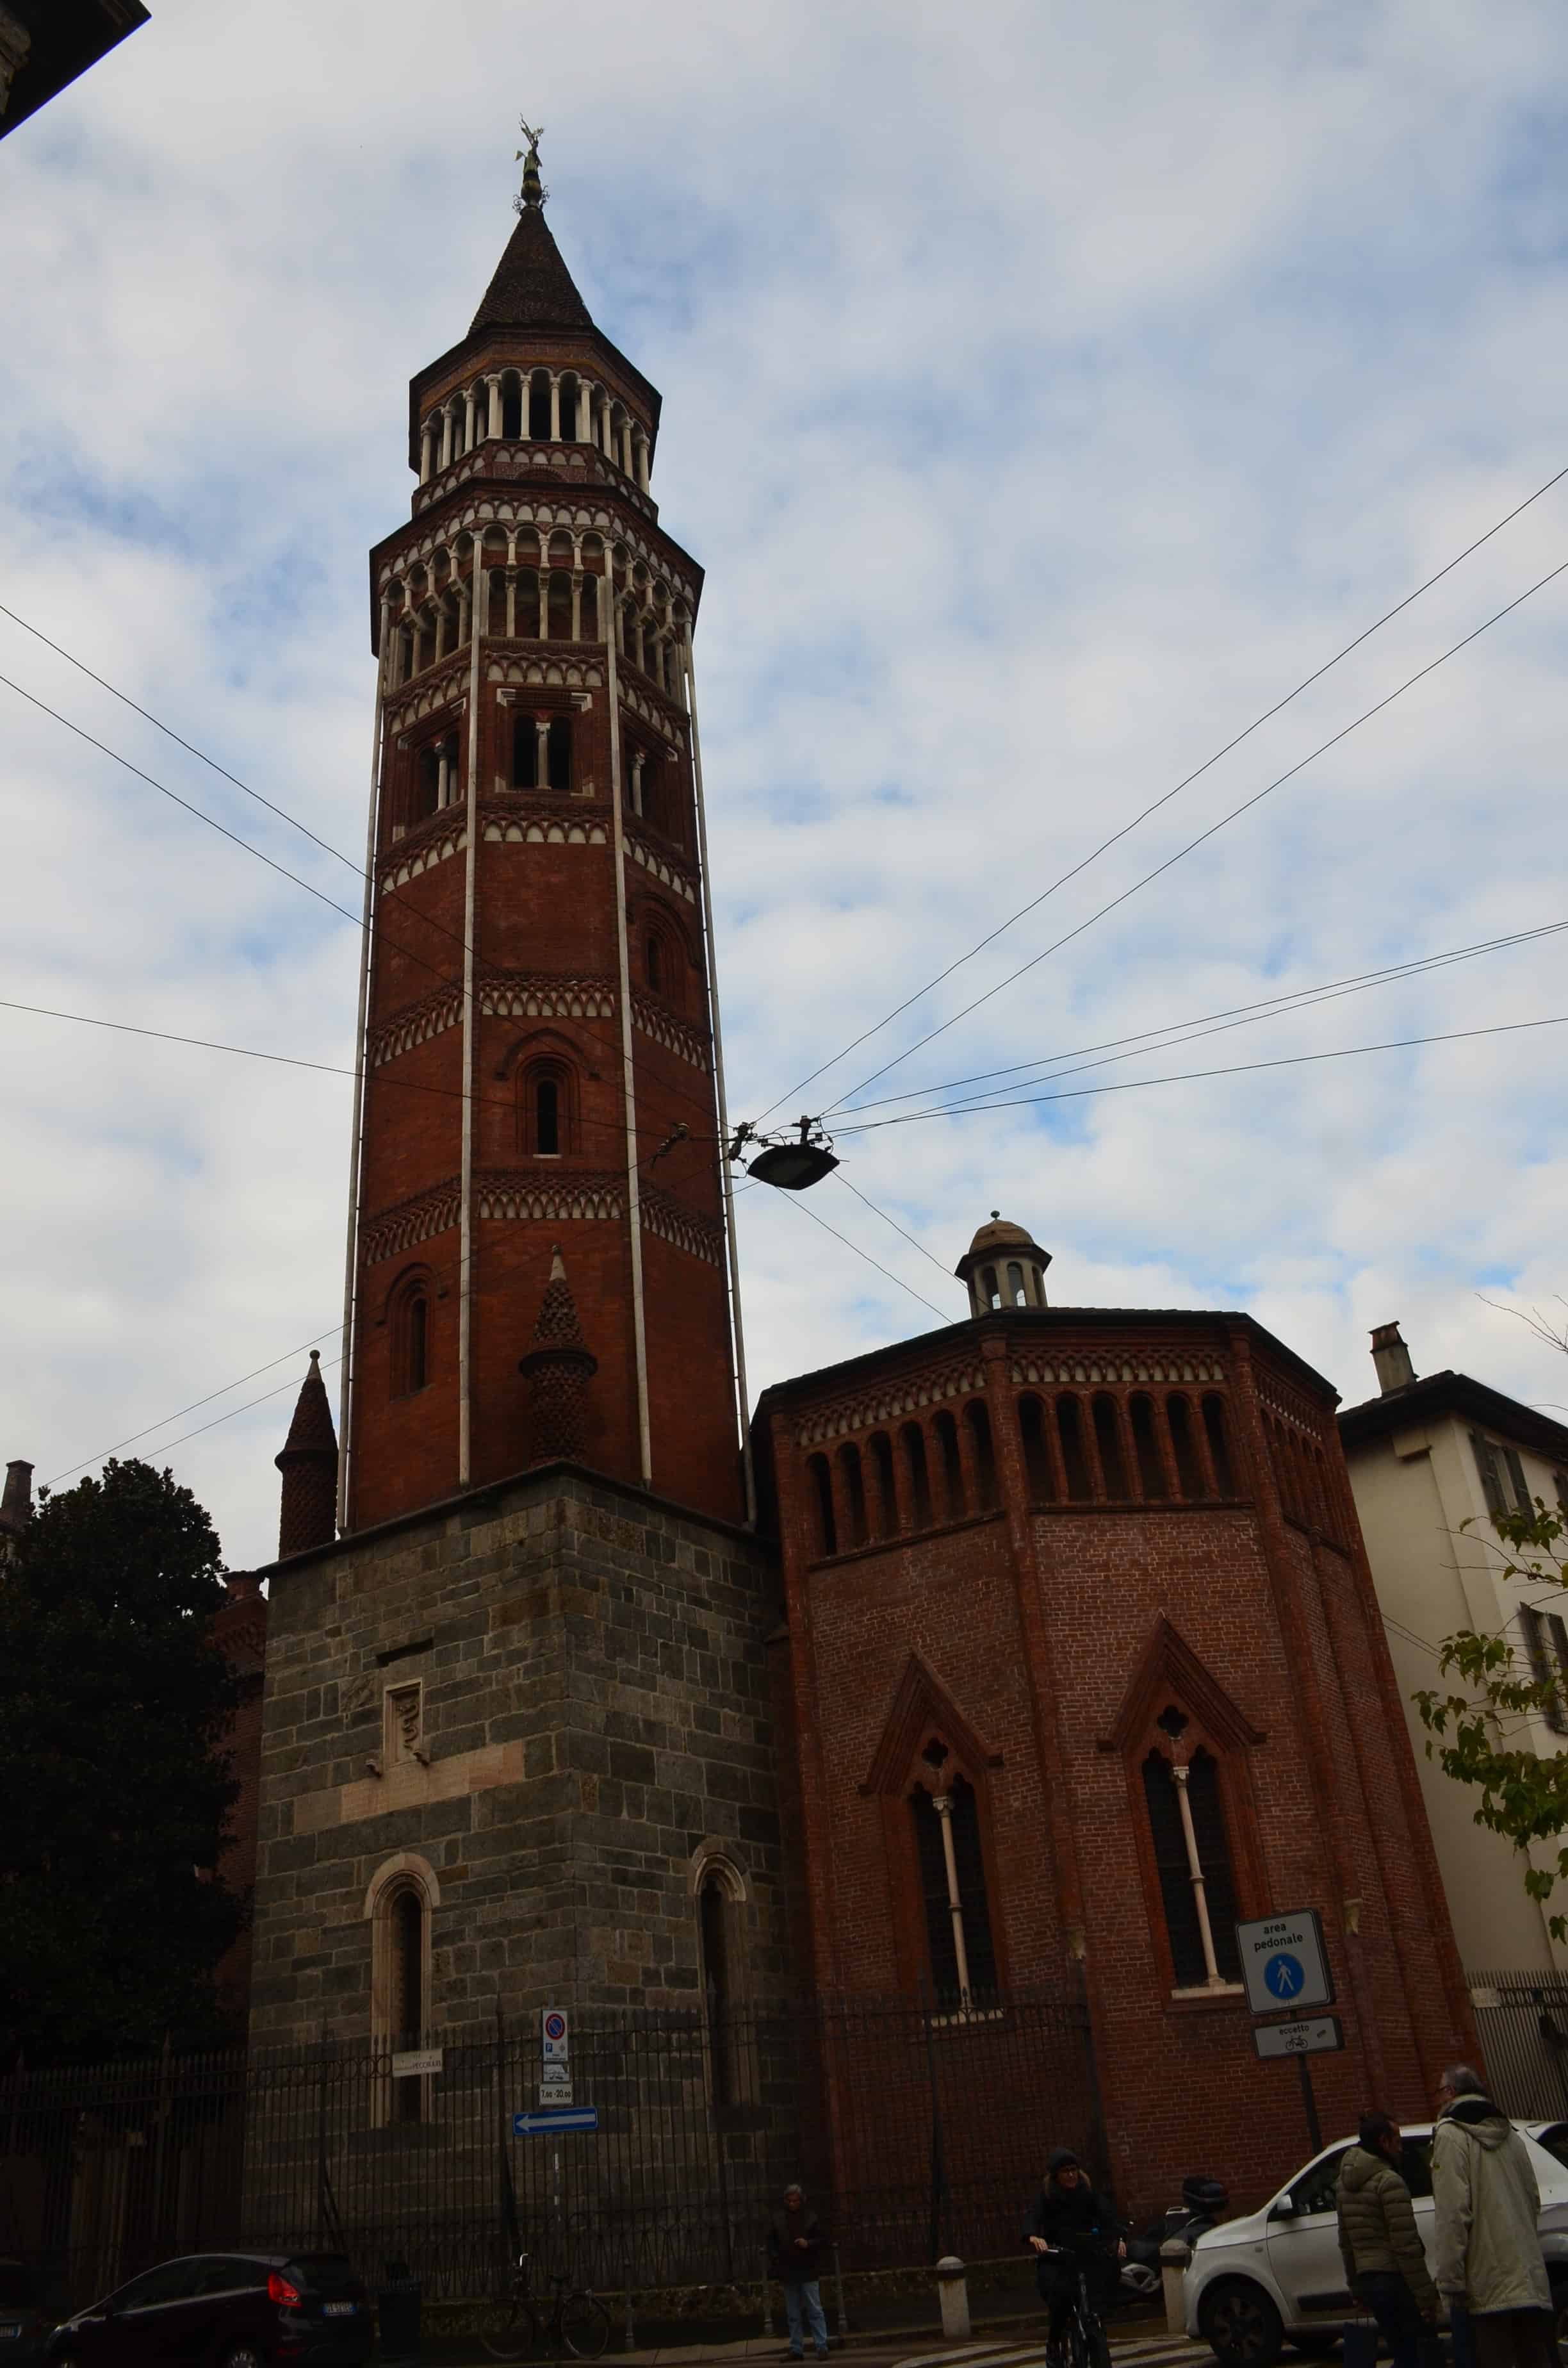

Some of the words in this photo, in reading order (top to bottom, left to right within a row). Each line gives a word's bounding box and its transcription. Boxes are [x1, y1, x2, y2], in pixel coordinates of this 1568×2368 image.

[1264, 1923, 1287, 1935] area
[1254, 1933, 1303, 1953] pedonale
[1279, 2024, 1310, 2035] eccetto
